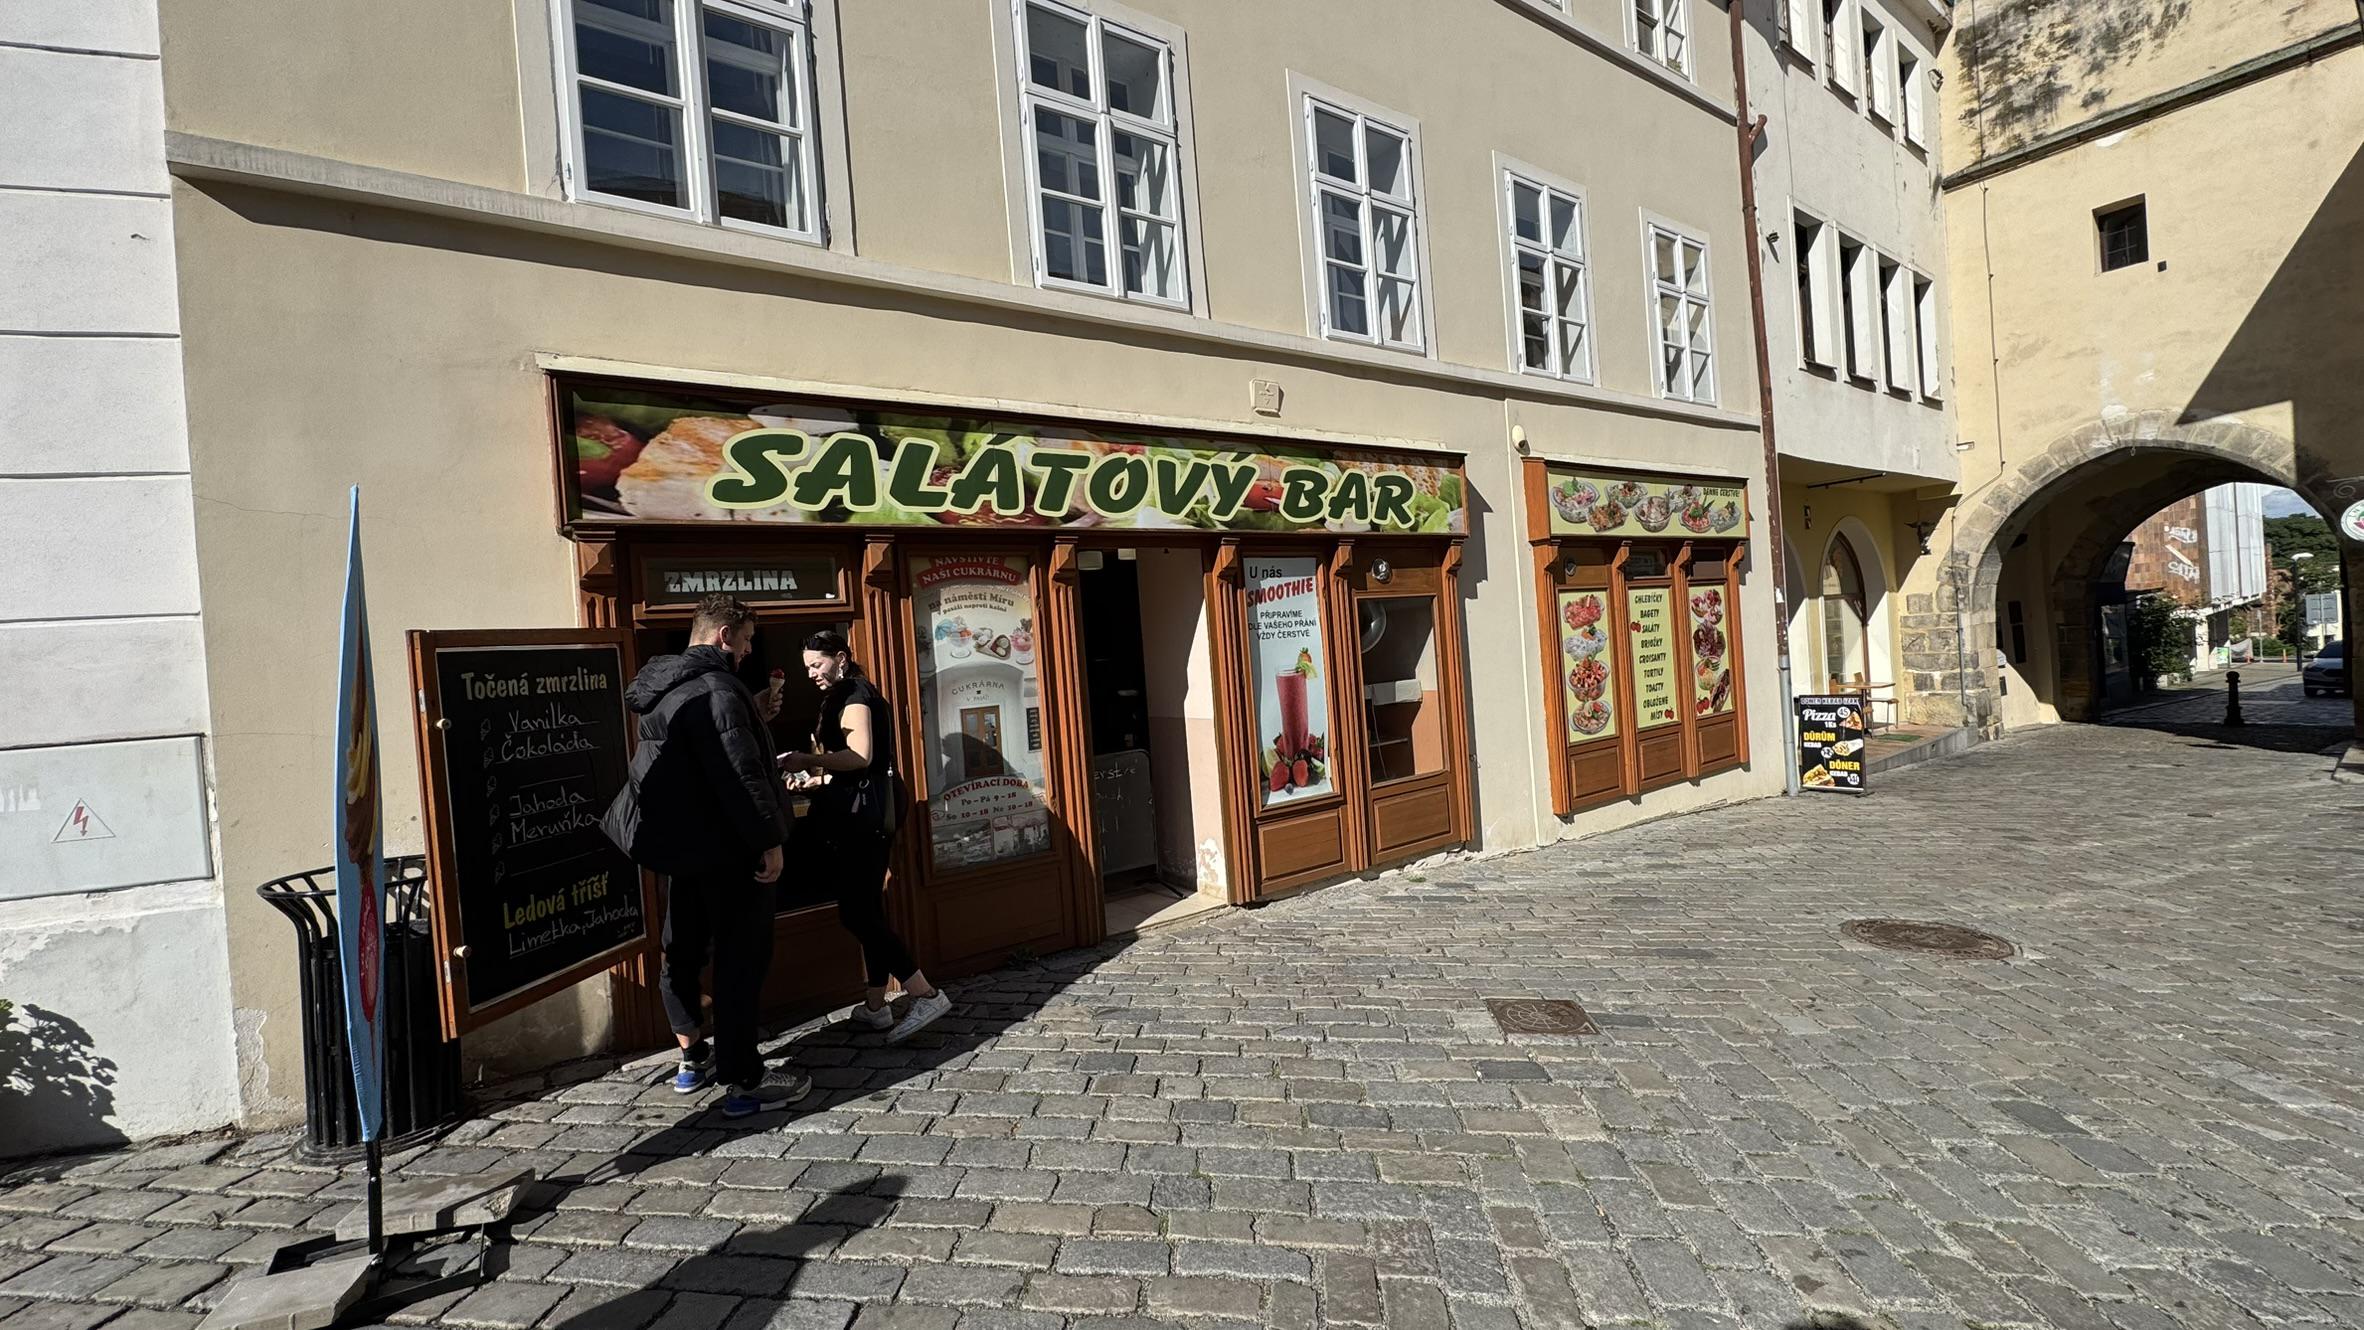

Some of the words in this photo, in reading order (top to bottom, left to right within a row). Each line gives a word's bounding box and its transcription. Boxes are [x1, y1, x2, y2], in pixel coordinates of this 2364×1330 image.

[708, 431, 1258, 520] SALÁTOVÝ
[1281, 466, 1415, 527] BAR
[952, 566, 1017, 582] CUKRÁRNU
[1249, 565, 1258, 579] U
[1261, 565, 1283, 579] nás
[663, 569, 798, 593] ZMRZLINA
[1247, 577, 1314, 608] SMOOTHIE
[928, 599, 942, 611] na
[944, 592, 987, 605] náměstí
[989, 593, 1015, 607] Míru
[1260, 609, 1303, 619] PŘIPRAVÍME
[1640, 609, 1660, 618] BAGETY
[1248, 622, 1262, 631] DLE
[1263, 619, 1293, 630] VAŠEHO
[1294, 617, 1317, 627] PŘÁNÍ
[1256, 630, 1276, 640] VŽDY
[1277, 628, 1310, 639] ČERSTVÉ
[461, 672, 530, 701] Točená
[536, 666, 608, 695] zmrzlina
[951, 680, 1005, 695] CUKRÁRNA
[1645, 682, 1664, 693] TOASTY
[508, 702, 583, 732] Vanilka
[1802, 709, 1836, 721] Pizza
[1803, 730, 1836, 741] DÜRÜM
[501, 731, 594, 761] Čokoláda
[1829, 758, 1860, 770] DÖNER
[1002, 778, 1029, 789] DOBA
[508, 785, 587, 817] Jahoda
[961, 798, 972, 806] Po
[510, 806, 602, 843] Meruňka
[503, 887, 566, 929] Ledová
[571, 871, 609, 906] tříšť
